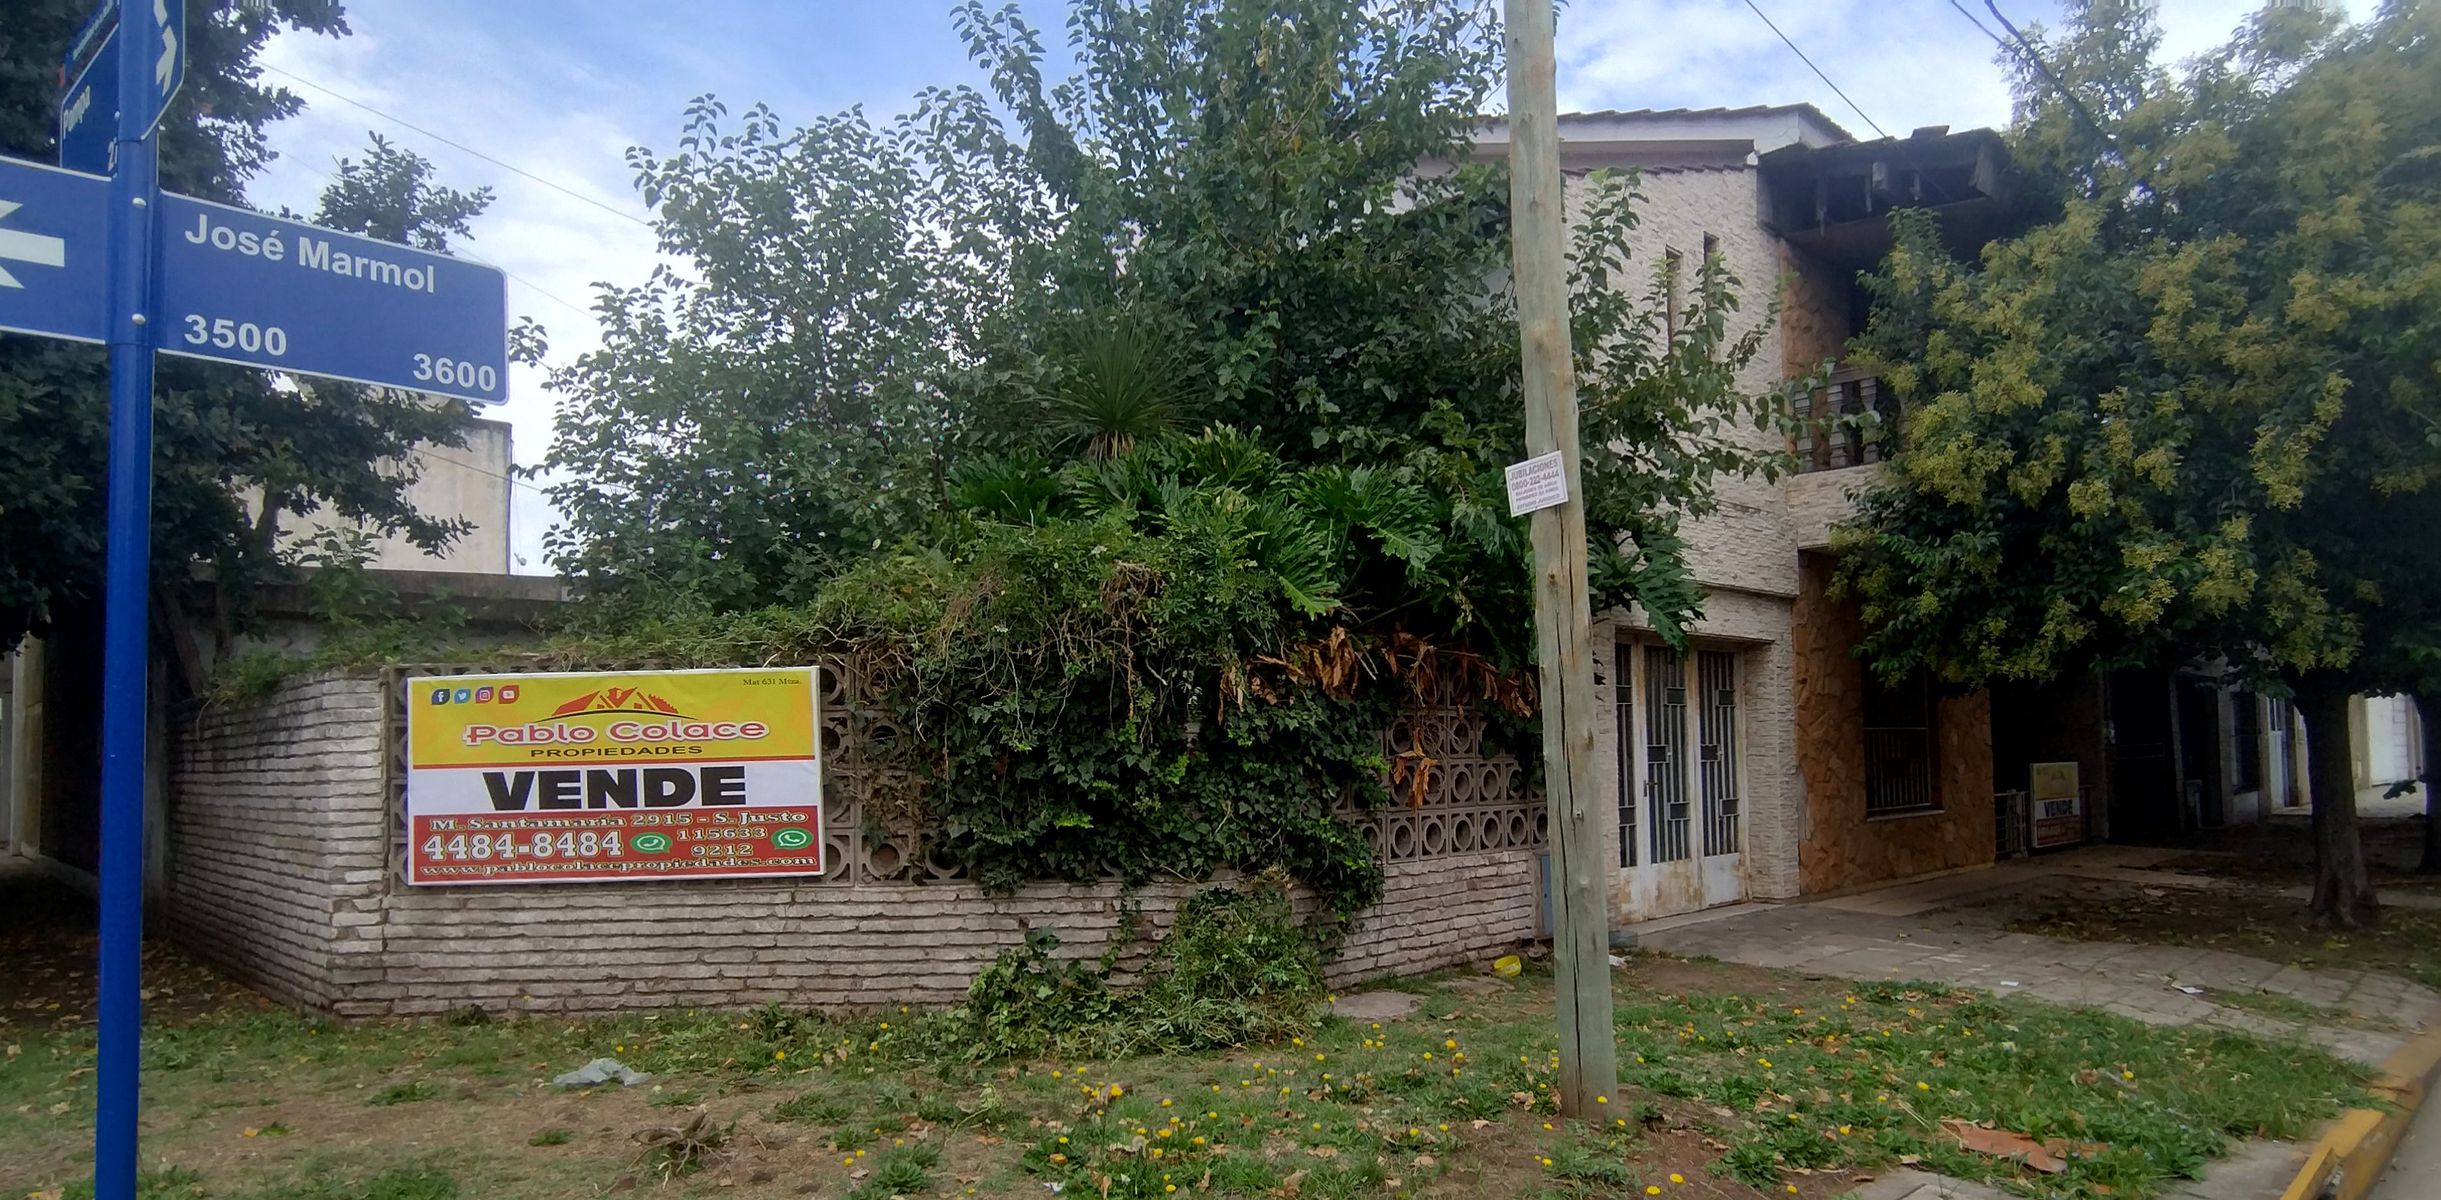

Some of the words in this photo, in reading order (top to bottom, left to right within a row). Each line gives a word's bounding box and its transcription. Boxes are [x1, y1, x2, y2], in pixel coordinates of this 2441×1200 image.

[185, 213, 284, 260] José
[299, 236, 435, 293] Marmol
[184, 314, 288, 356] 3500
[412, 353, 497, 392] 3600
[1510, 458, 1558, 481] JUBILACIONES
[743, 678, 759, 686] Mat
[761, 678, 776, 686] 631
[465, 721, 597, 745] Pablo
[607, 720, 768, 742] Colace
[530, 746, 703, 758] PROPIEDADES
[482, 766, 747, 811] VENDE
[431, 817, 465, 830] M.
[631, 813, 693, 826] 2915
[714, 812, 735, 825] S.
[737, 811, 808, 826] Justo
[677, 827, 767, 841] 115633
[422, 831, 625, 861] 4484-8484
[691, 844, 753, 857] 9212
[421, 856, 816, 875] www.pablocolacepropiedades.com
